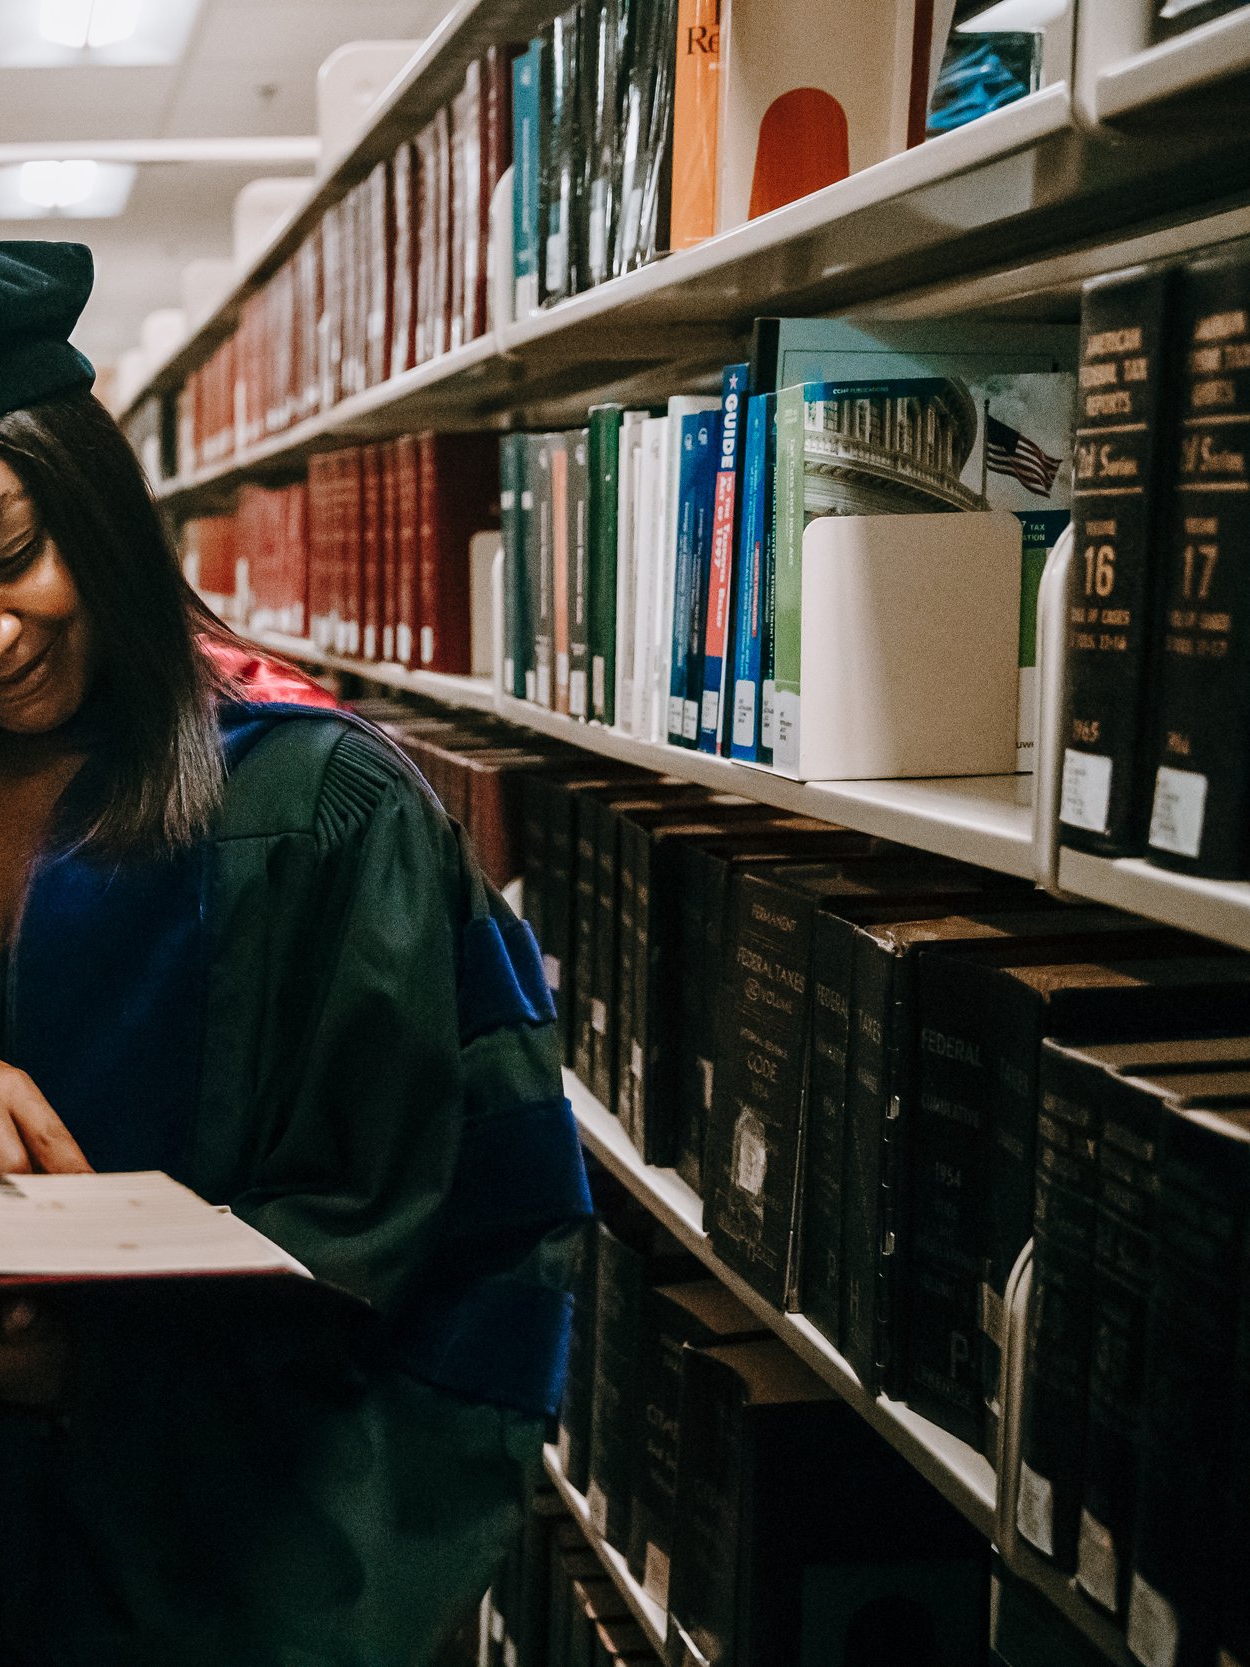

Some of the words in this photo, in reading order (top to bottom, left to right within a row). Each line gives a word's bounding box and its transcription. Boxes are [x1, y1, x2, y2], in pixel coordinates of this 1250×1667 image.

[720, 393, 739, 468] GUIDE
[1084, 545, 1116, 597] 16
[1182, 545, 1218, 599] 17
[744, 1051, 779, 1082] CODE
[921, 1027, 983, 1070] FEDERAL
[951, 1330, 969, 1378] P
